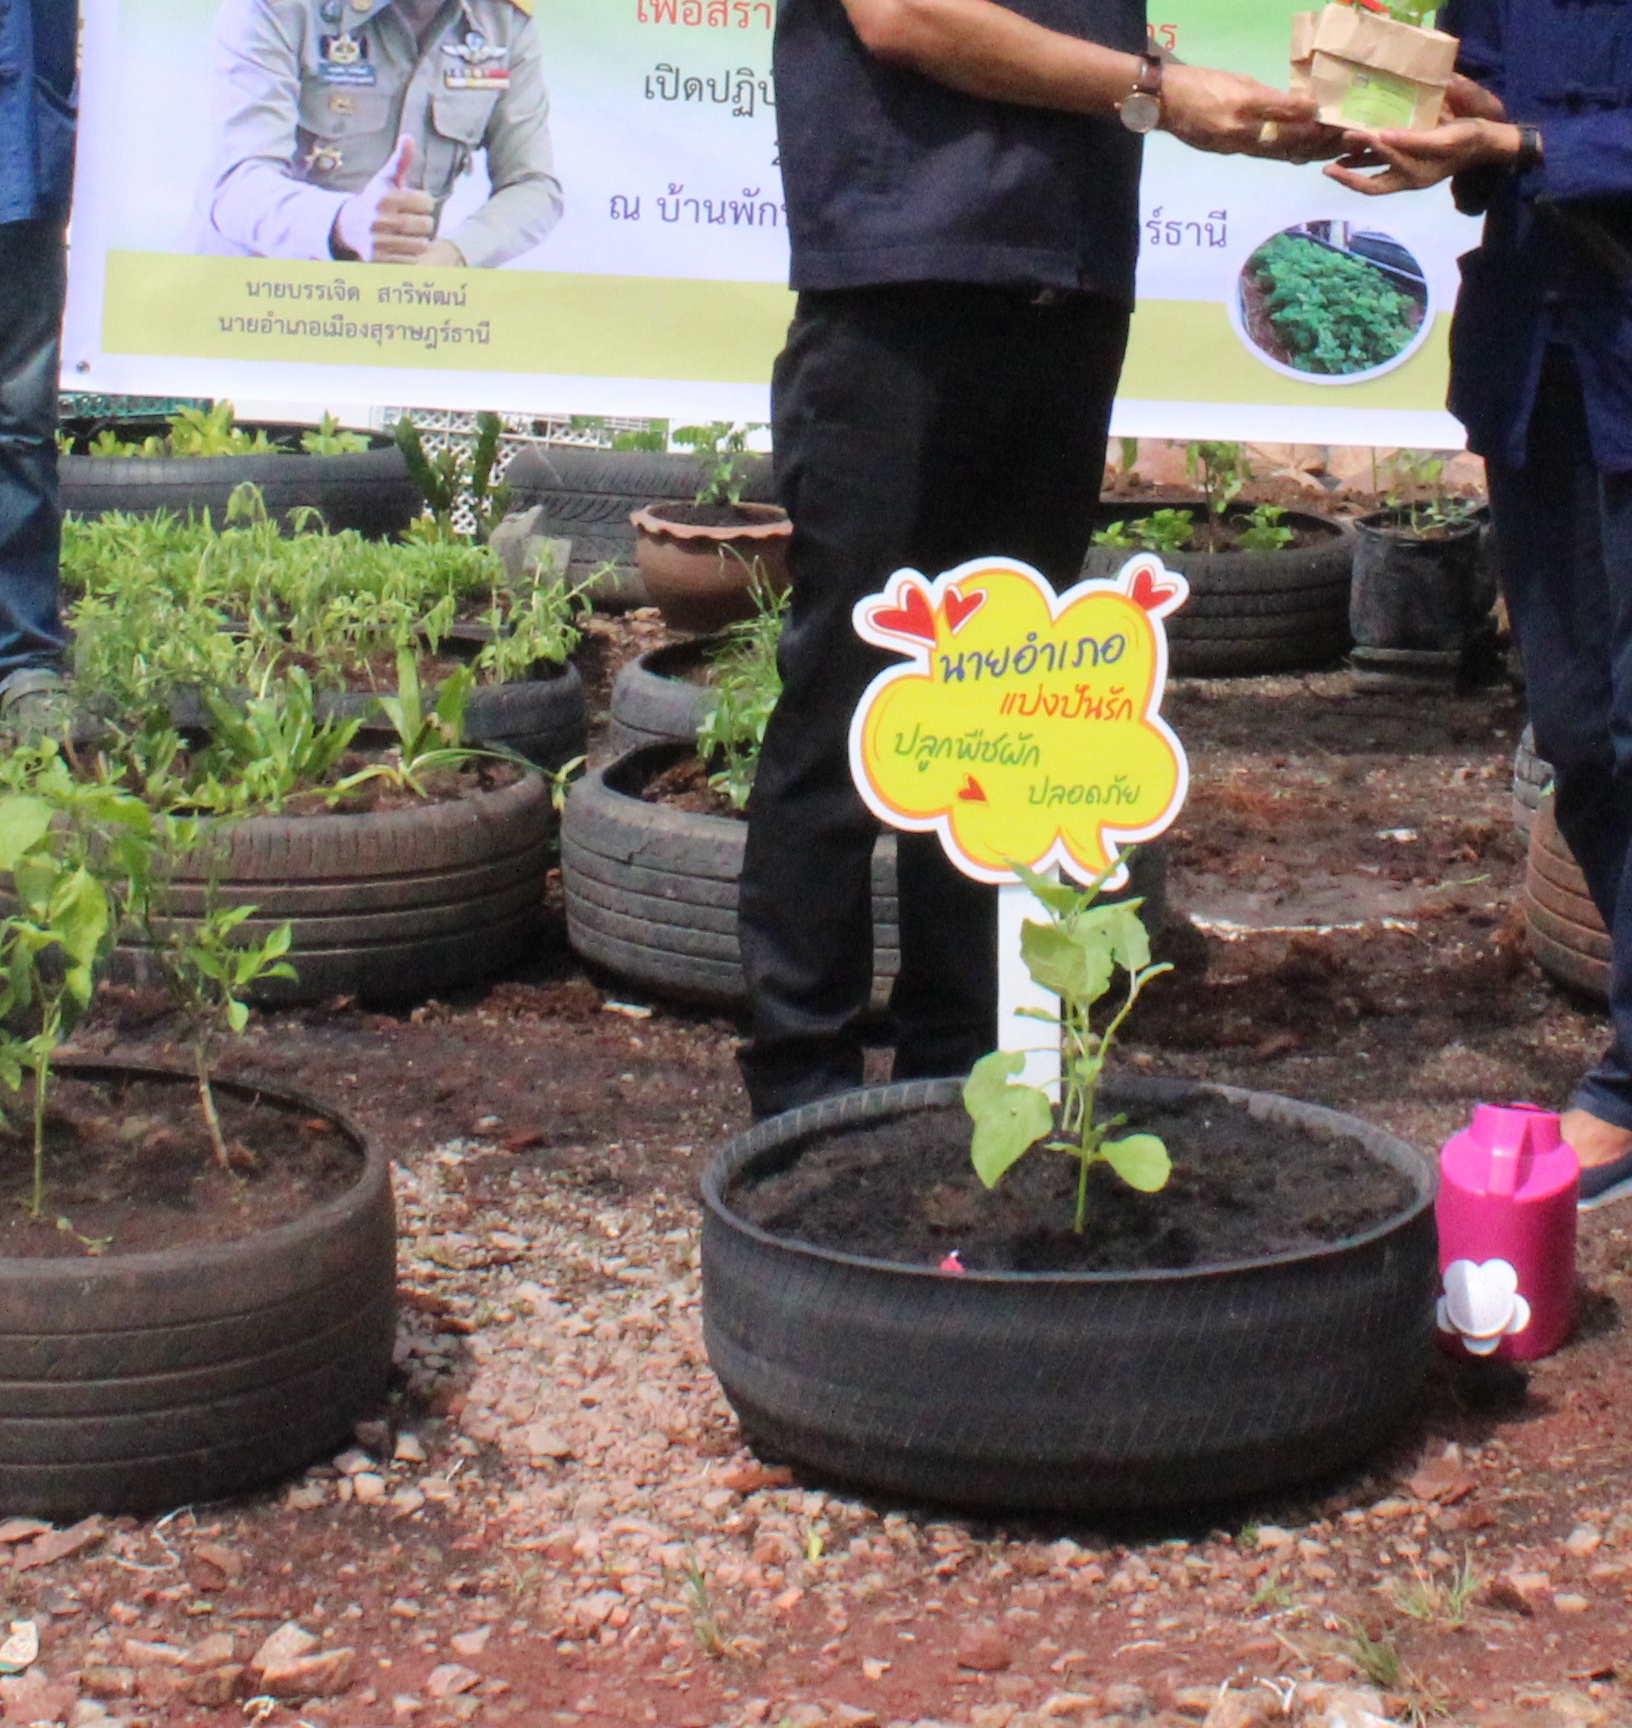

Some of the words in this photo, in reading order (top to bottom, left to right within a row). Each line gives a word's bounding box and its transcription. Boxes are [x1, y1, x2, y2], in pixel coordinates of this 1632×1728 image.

[609, 194, 641, 221] ณ
[656, 182, 787, 228] บ้านพัก
[246, 278, 361, 302] นายบรรเจิด
[377, 281, 468, 308] สาริพัฒน์
[218, 310, 492, 350] นายอำเภอเมืองสุราษฎร์ธานี
[939, 631, 1126, 684] นายอำเภอ
[894, 722, 1041, 773] ปลูกพืชผัก
[1027, 774, 1141, 808] ปลอดภัย
